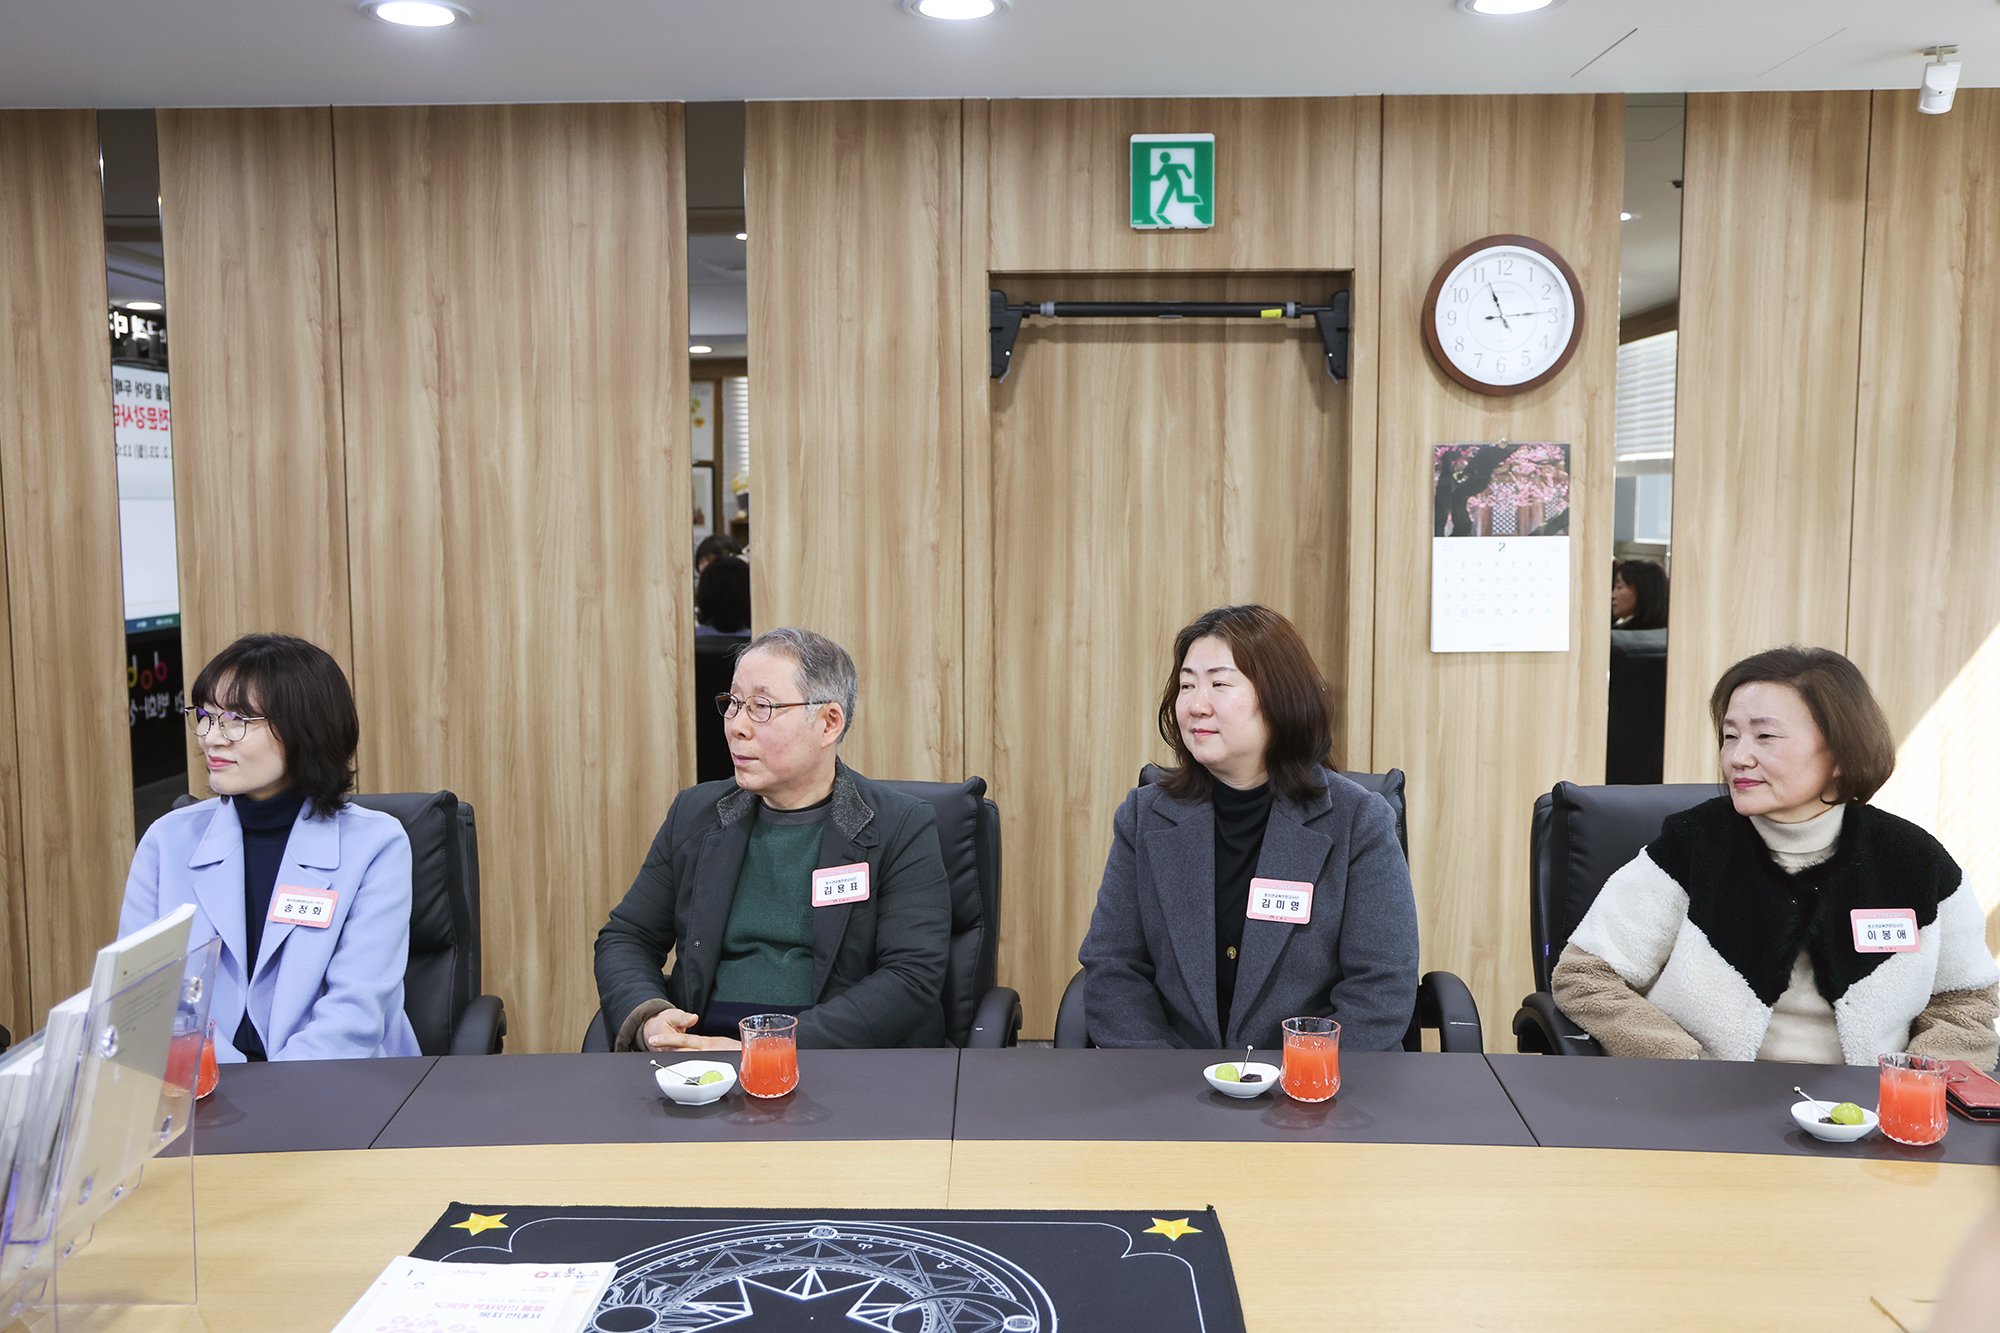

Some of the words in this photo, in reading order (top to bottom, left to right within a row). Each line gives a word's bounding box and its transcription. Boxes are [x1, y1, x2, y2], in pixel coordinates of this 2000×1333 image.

[1473, 267, 1485, 283] 11
[1497, 259, 1514, 276] 12
[1528, 267, 1534, 282] 1
[1452, 287, 1469, 303] 10
[1541, 283, 1551, 300] 2
[1447, 310, 1457, 326] 9
[1548, 307, 1558, 324] 3
[1455, 336, 1464, 352] 8
[1539, 334, 1549, 350] 4
[1474, 353, 1483, 369] 7
[1496, 357, 1506, 373] 6
[1521, 351, 1531, 366] 5
[1498, 541, 1506, 552] 2
[1262, 899, 1300, 911] 김미영
